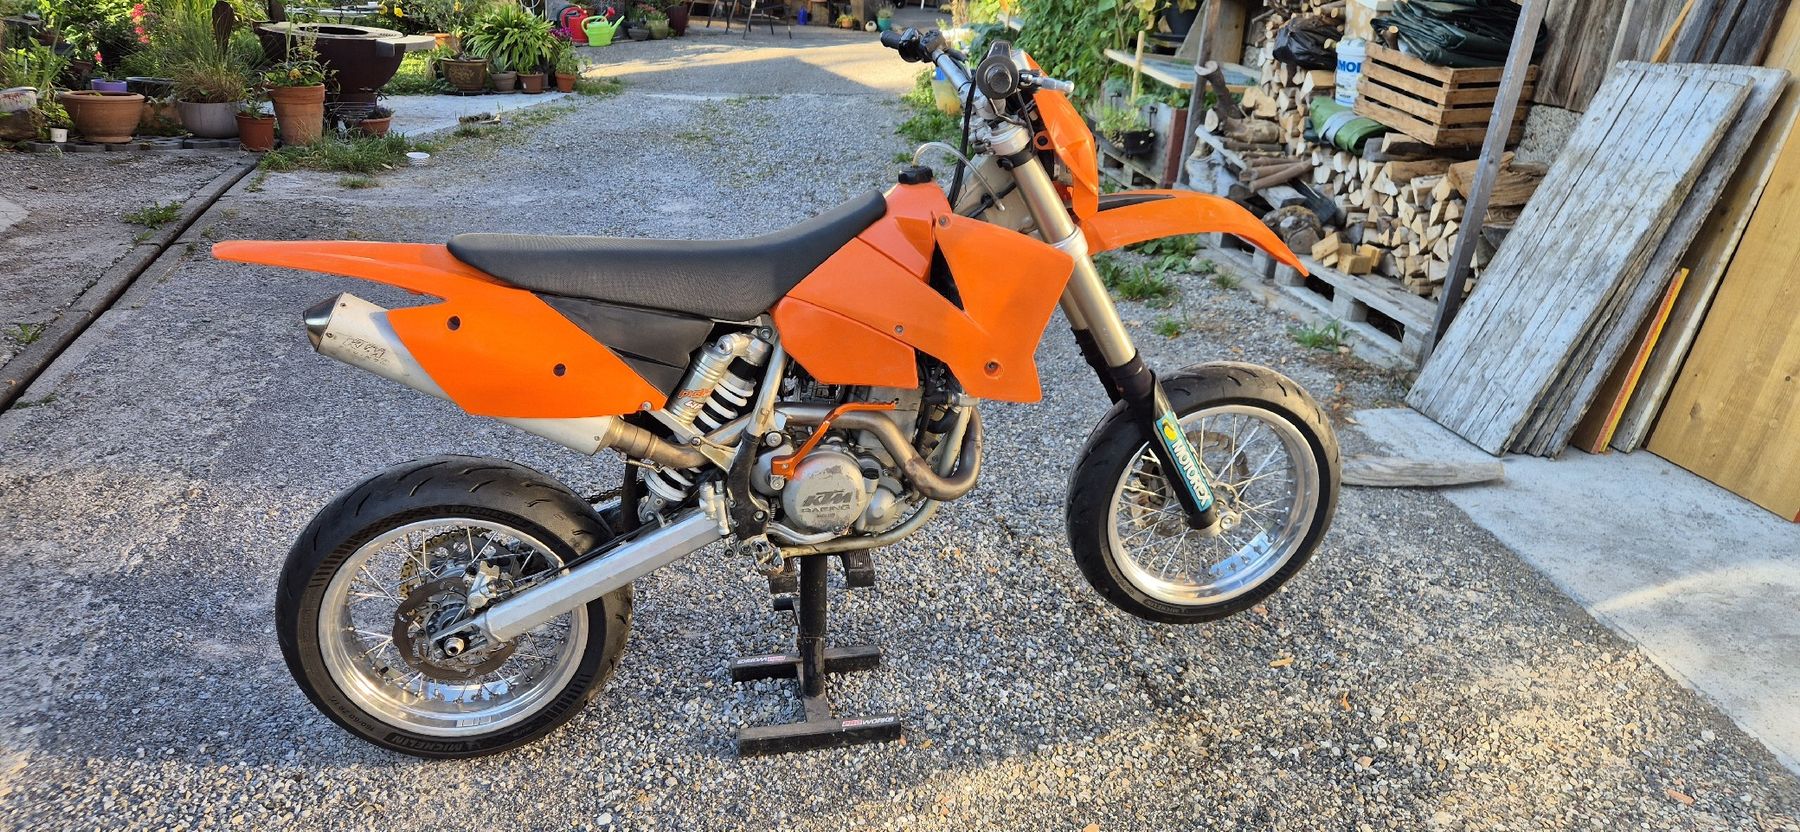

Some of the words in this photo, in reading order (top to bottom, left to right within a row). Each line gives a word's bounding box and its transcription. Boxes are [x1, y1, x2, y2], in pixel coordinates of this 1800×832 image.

[1171, 439, 1211, 507] MOTOREX
[802, 489, 853, 507] KTM
[391, 735, 463, 752] MICHELIN
